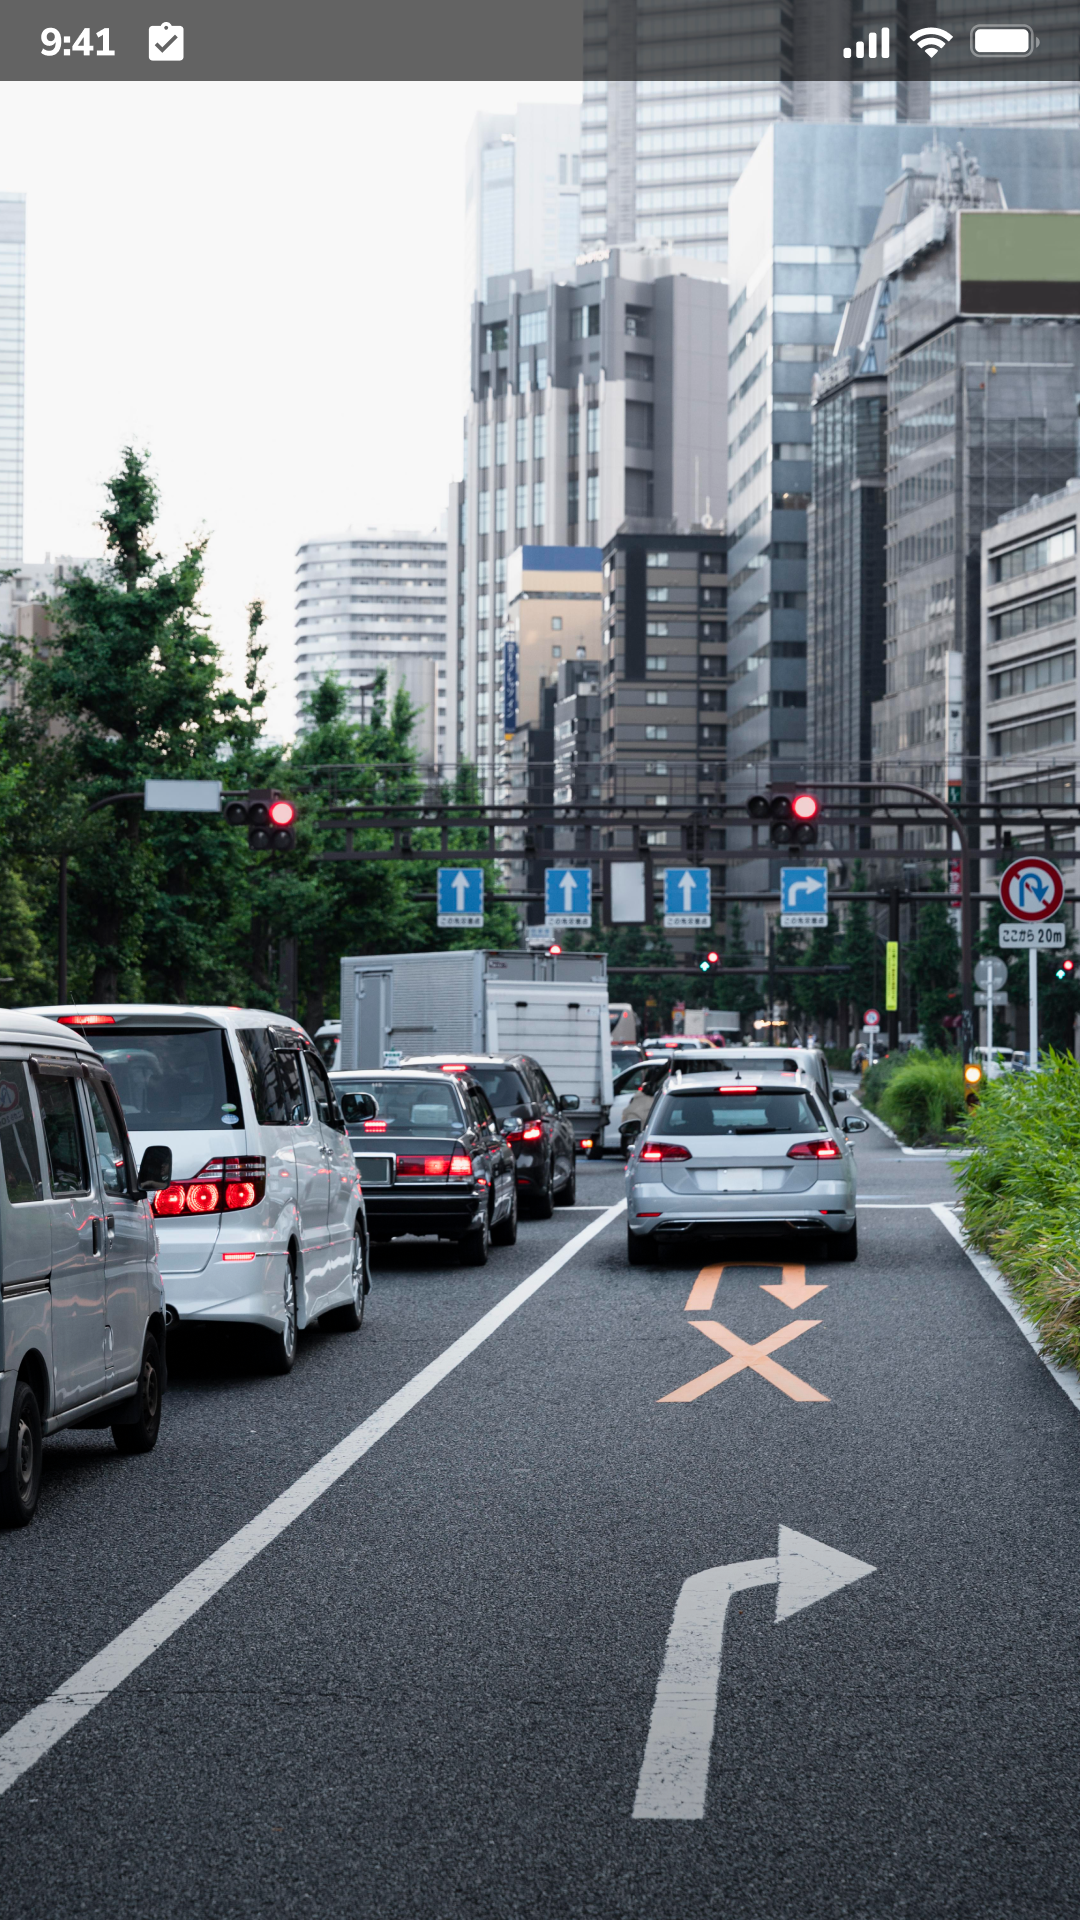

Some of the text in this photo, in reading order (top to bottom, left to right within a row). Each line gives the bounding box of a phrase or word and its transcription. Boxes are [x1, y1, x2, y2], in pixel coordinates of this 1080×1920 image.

[1002, 928, 1062, 943] ここから 20m
